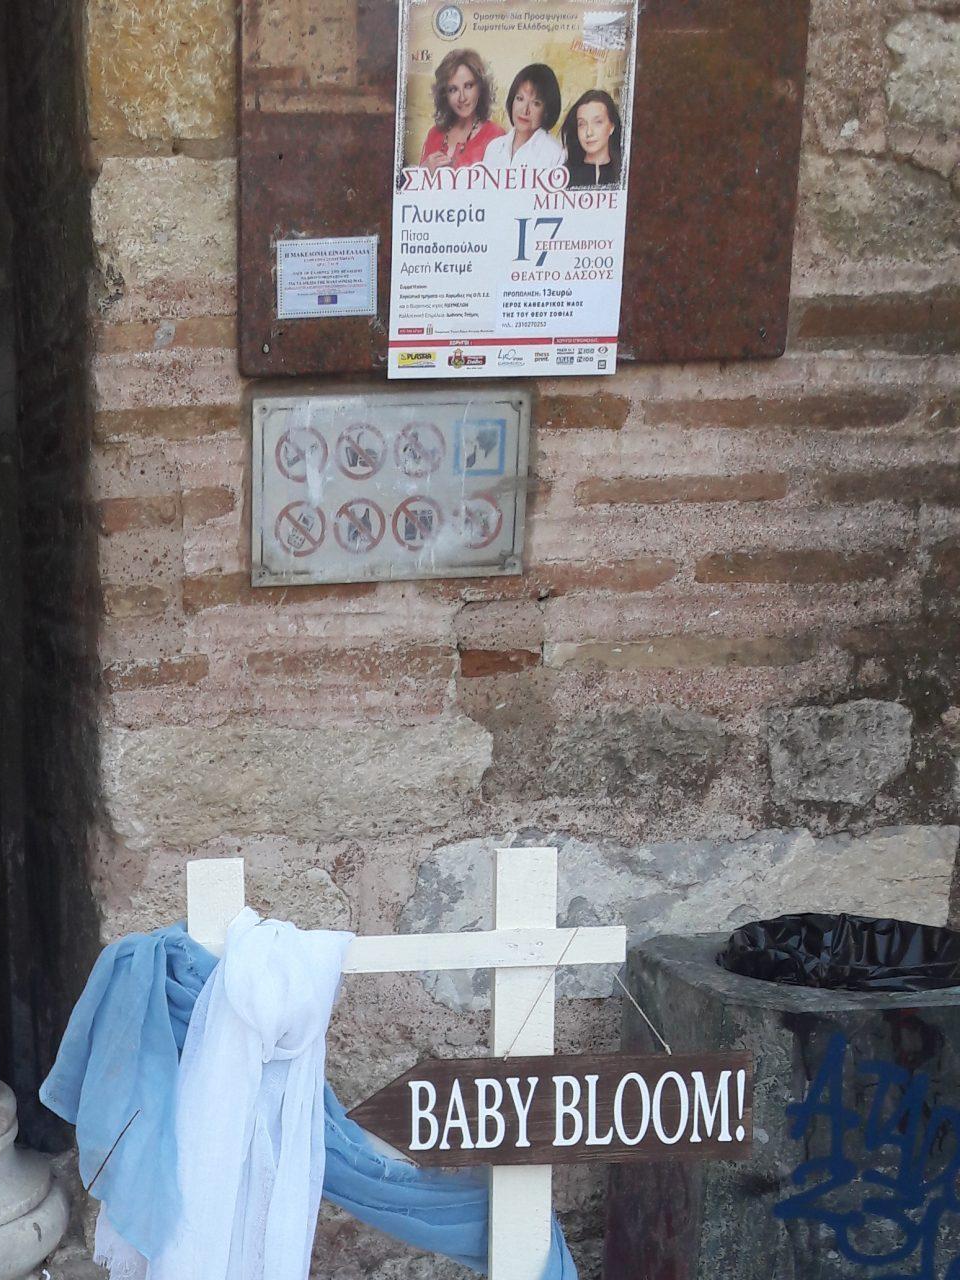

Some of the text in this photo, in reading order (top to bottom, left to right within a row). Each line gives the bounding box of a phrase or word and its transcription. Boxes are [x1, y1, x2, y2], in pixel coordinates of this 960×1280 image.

[402, 165, 568, 192] ΣΜΥΡΝΕΪΚΟ
[534, 192, 618, 210] ΜΙΝΟΡΕ
[401, 205, 485, 227] Γλυκερία
[401, 229, 429, 241] Πίτσα
[512, 217, 563, 267] 17
[400, 242, 488, 254] Παπαδοπούλου
[535, 240, 613, 251] ΣΕΠΤΕΜΒΡΙΟΥ
[400, 261, 473, 275] Αρετή Κετιμέ
[573, 256, 613, 269] 20:00
[511, 270, 614, 281] ΘΕΑΤΡΟ ΔΑΣΟΥΣ
[408, 1076, 539, 1151] BABY
[552, 1069, 746, 1147] BLOOM!
